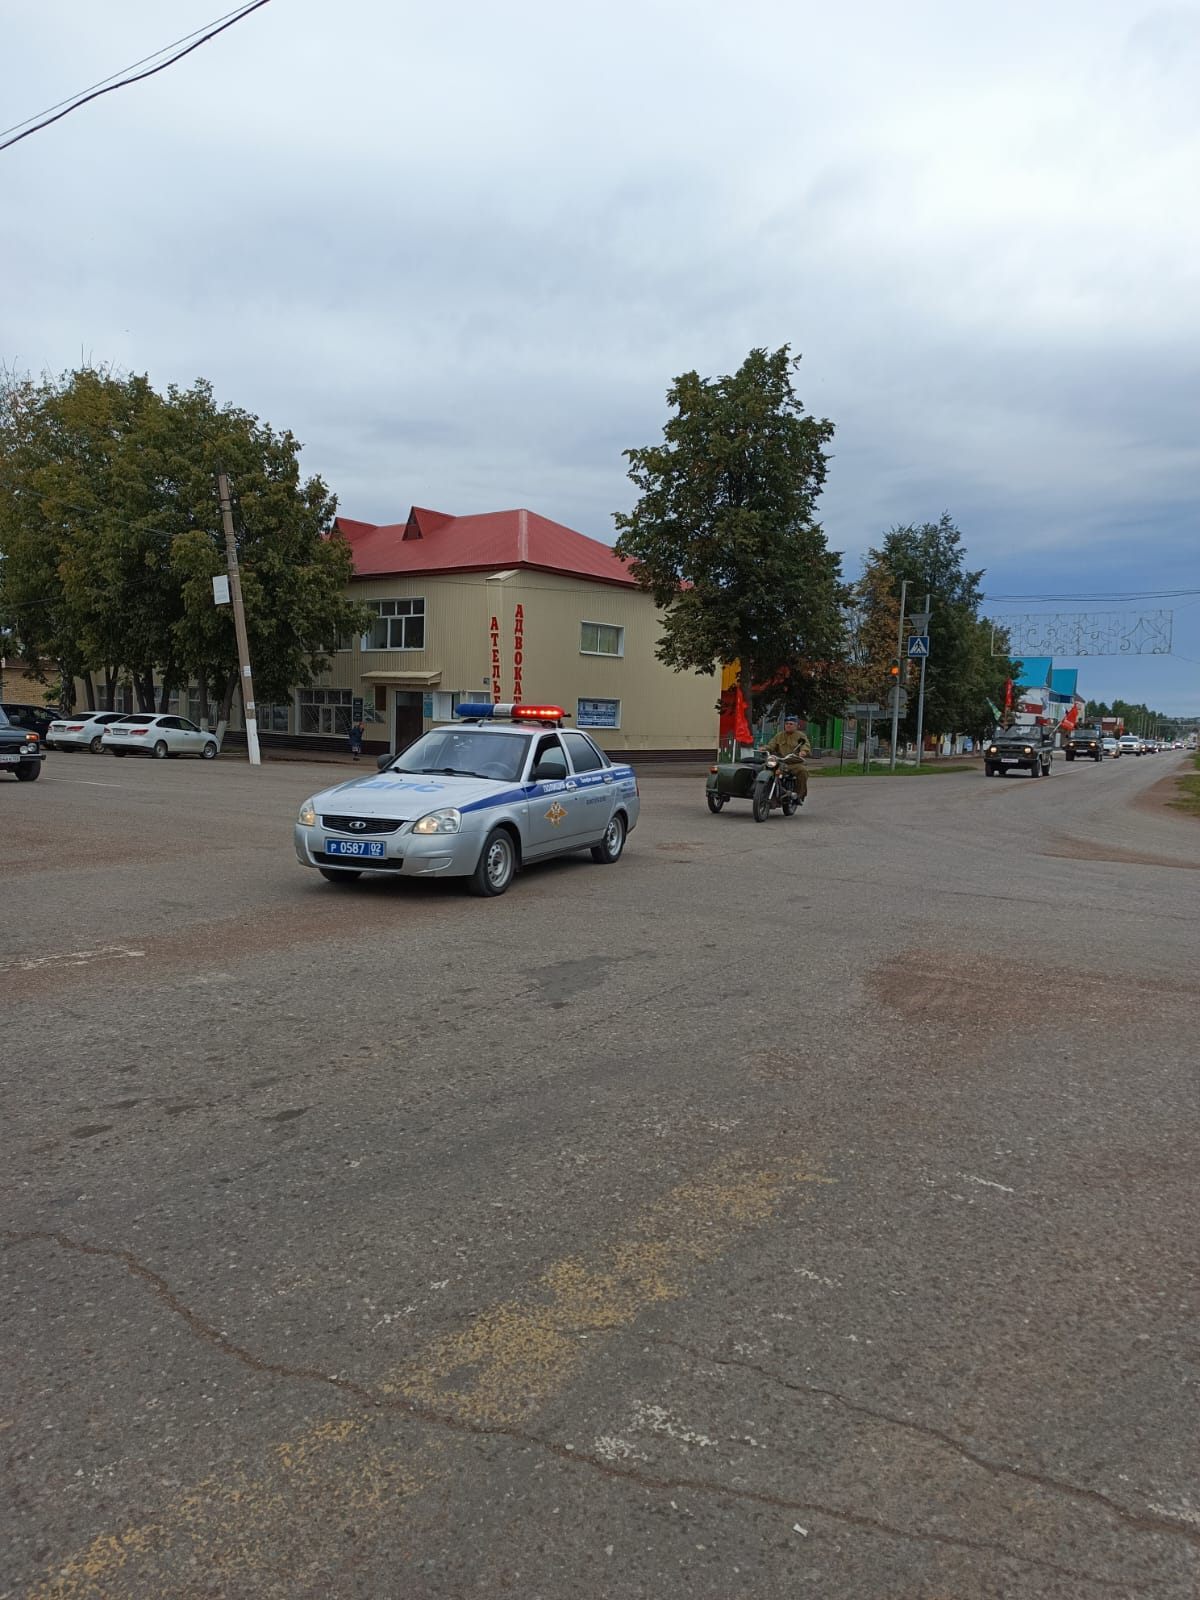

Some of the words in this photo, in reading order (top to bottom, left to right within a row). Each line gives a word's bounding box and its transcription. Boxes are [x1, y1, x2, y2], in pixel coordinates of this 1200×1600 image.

[355, 781, 444, 793] ДПС
[339, 842, 366, 854] 0587
[370, 843, 382, 852] 02
